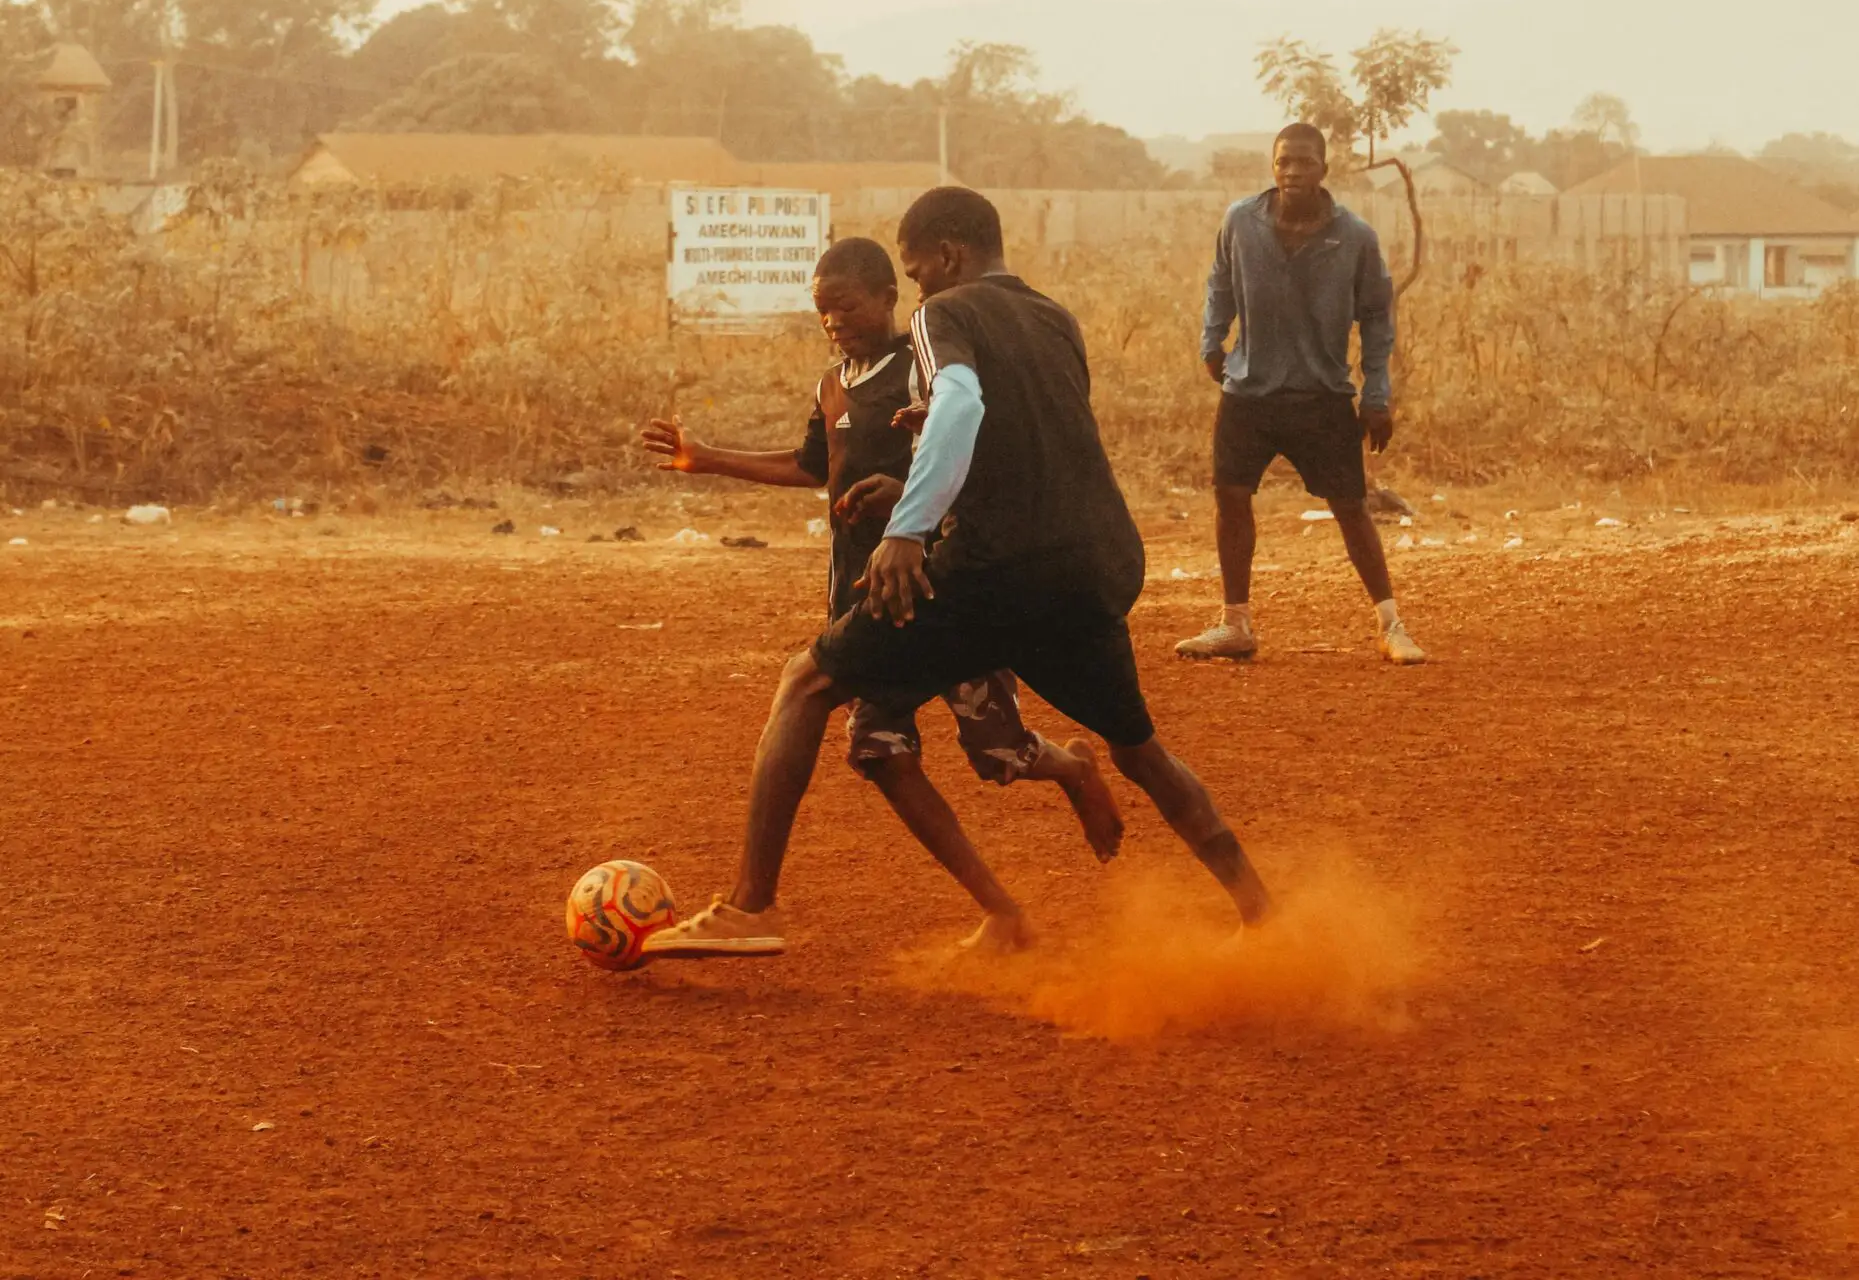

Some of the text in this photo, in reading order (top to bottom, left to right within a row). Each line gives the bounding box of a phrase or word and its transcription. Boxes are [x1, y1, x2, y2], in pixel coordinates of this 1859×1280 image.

[686, 195, 715, 215] SE
[698, 223, 806, 239] AMECHI-UWANI
[696, 270, 806, 285] AMECHI-UWANI
